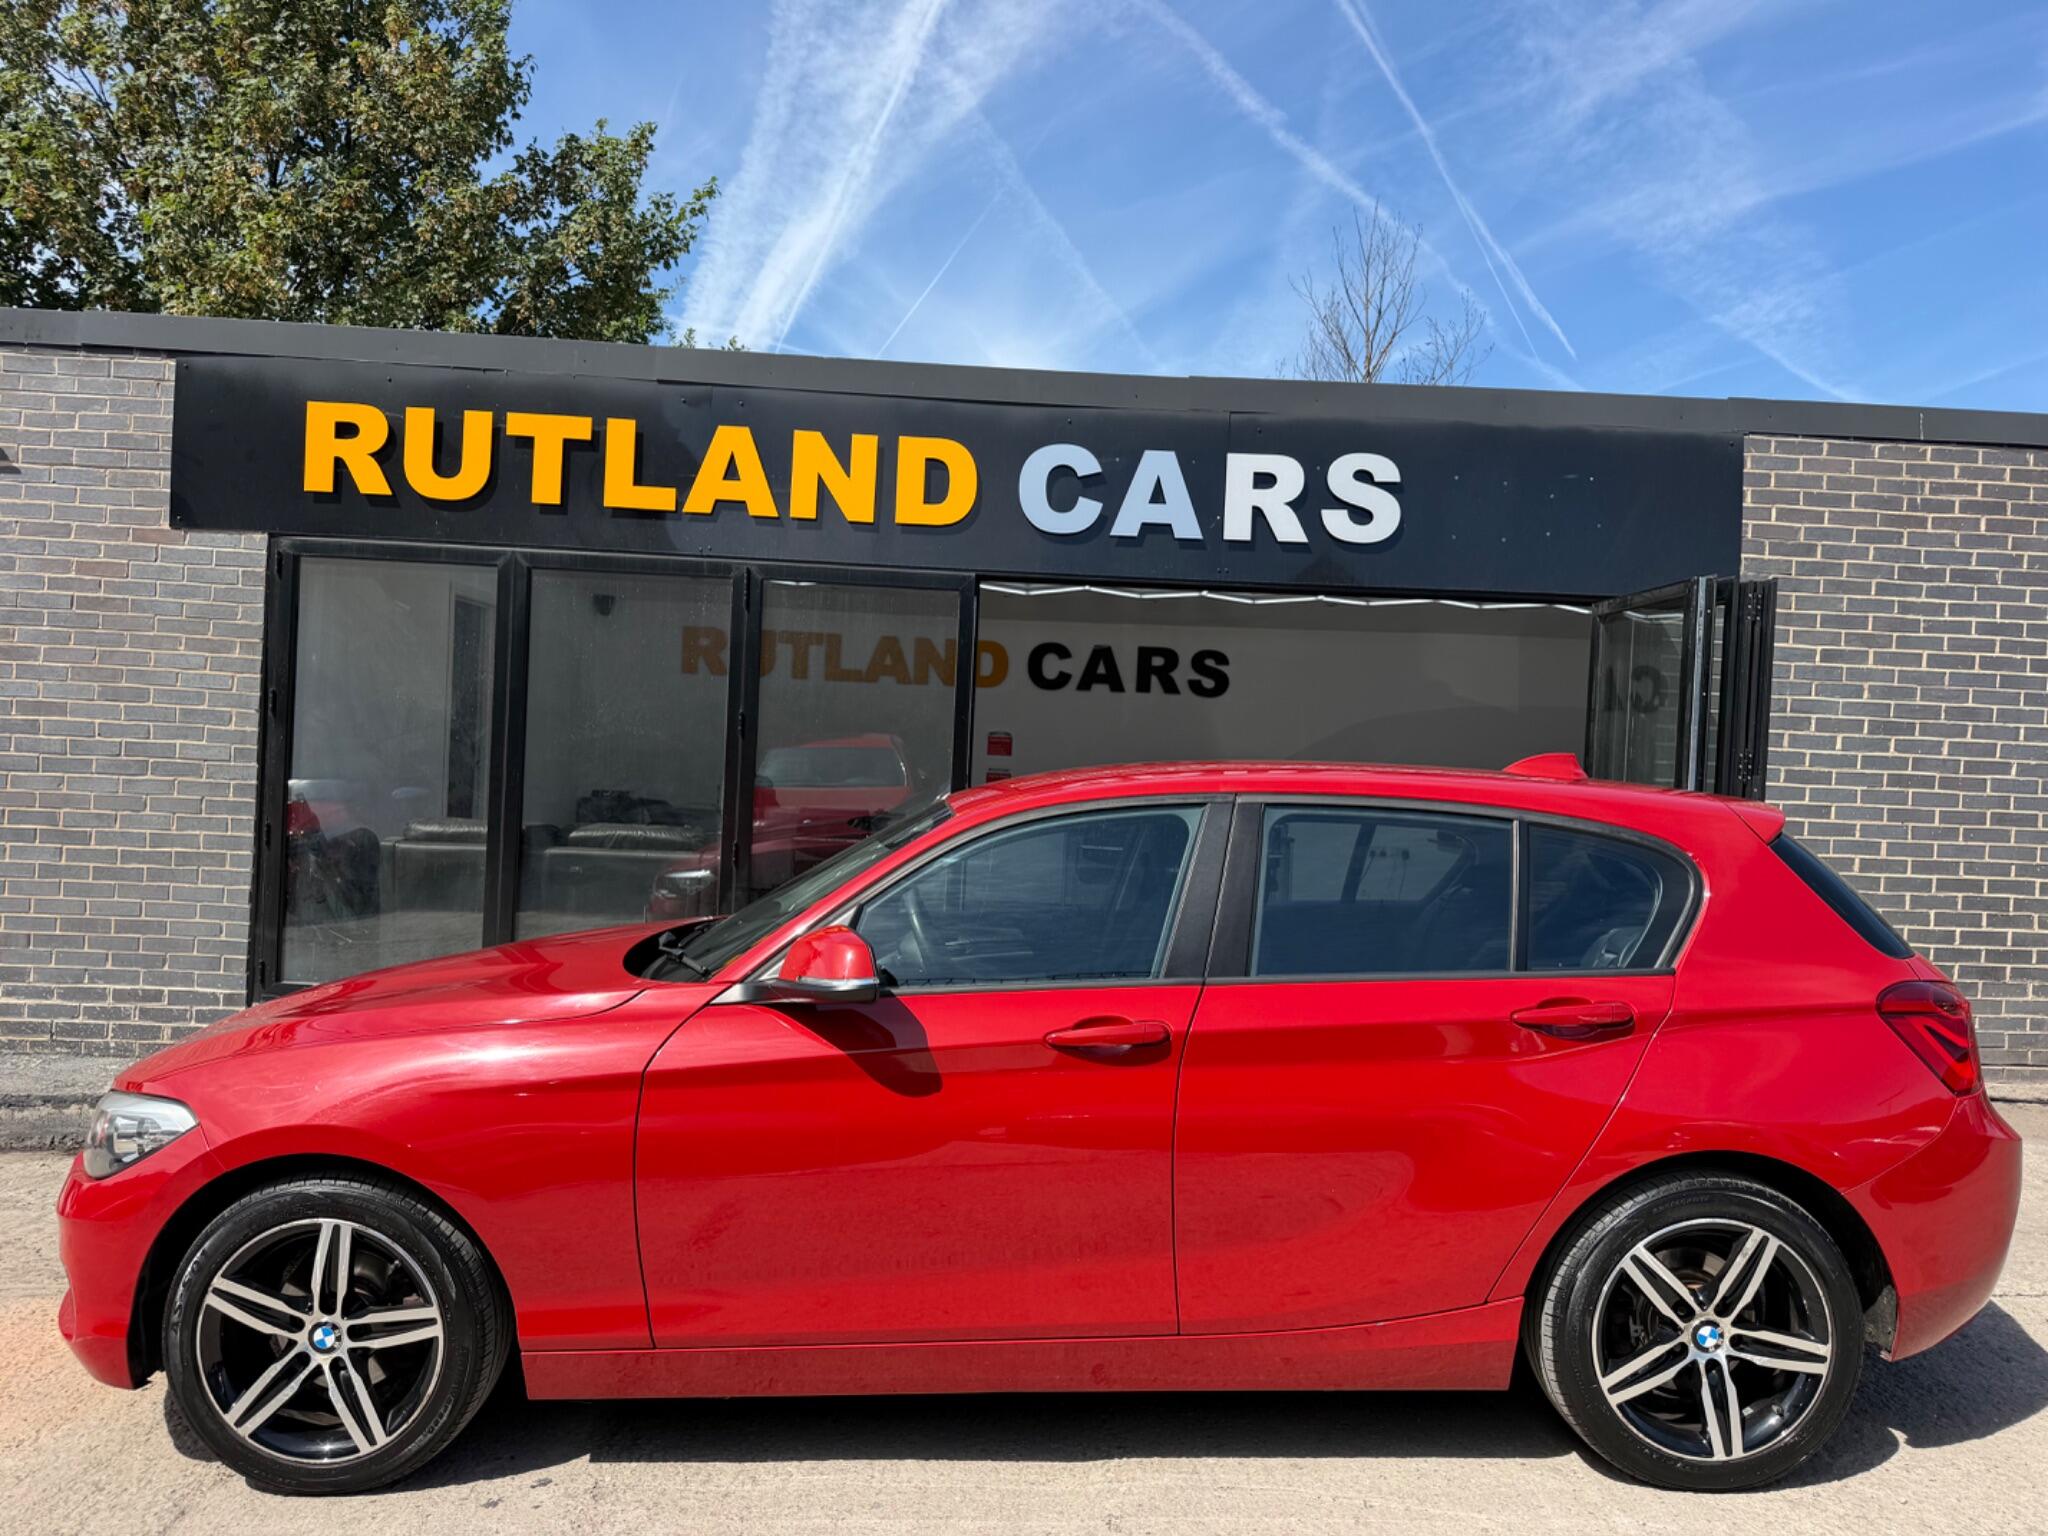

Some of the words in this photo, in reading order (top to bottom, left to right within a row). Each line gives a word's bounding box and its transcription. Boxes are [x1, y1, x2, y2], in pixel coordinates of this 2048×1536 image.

[303, 400, 978, 526] RUTLAND
[1018, 443, 1402, 544] CARS
[1027, 642, 1230, 698] CARS
